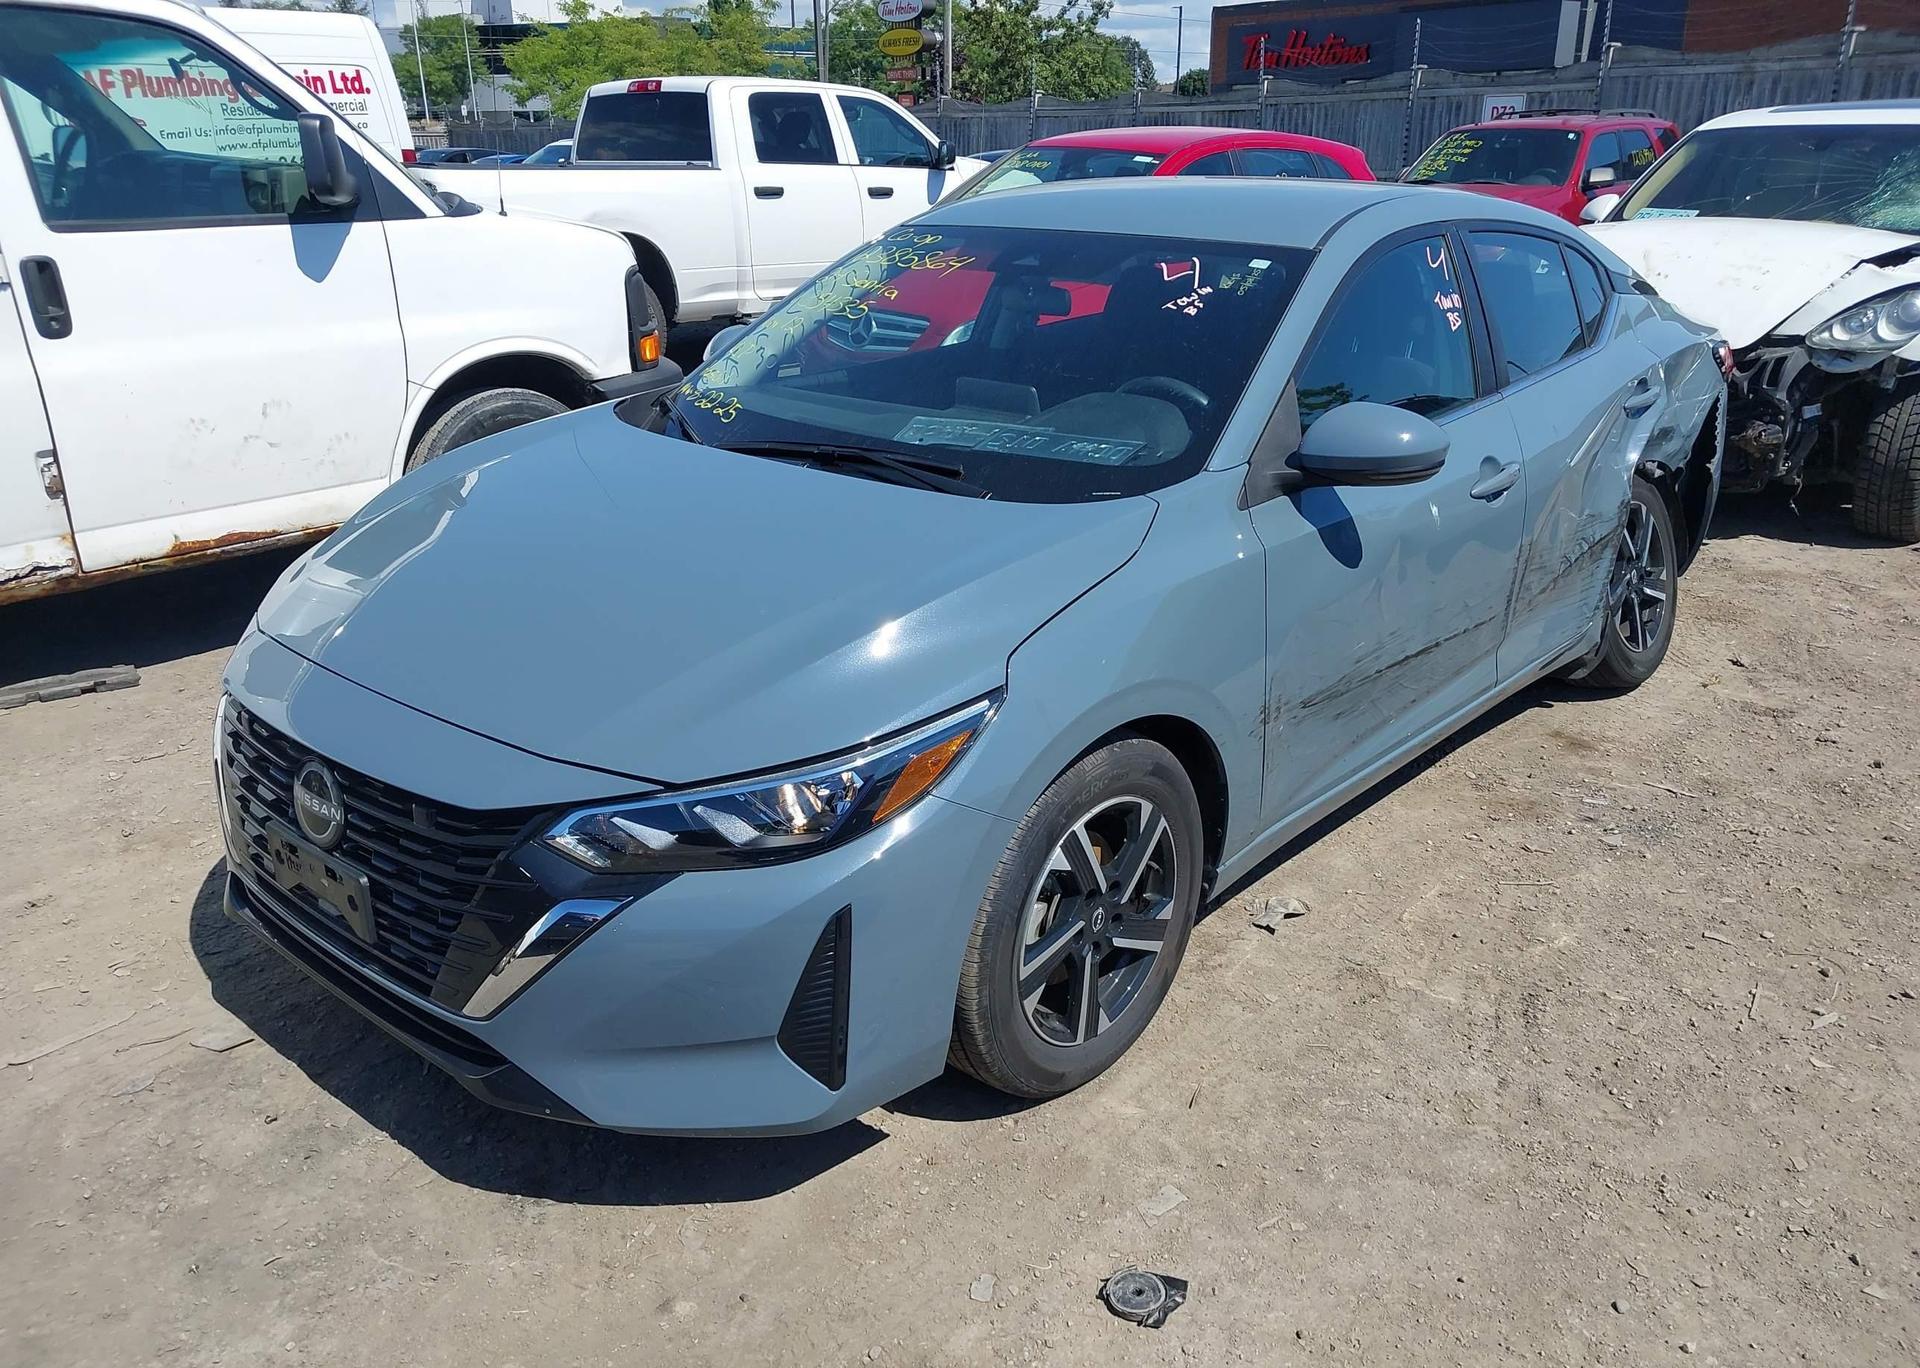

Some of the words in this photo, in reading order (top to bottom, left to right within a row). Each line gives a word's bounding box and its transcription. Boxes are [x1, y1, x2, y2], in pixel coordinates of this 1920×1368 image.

[881, 2, 895, 17] Tim
[902, 36, 920, 46] FRESH
[1280, 29, 1370, 69] Hortons
[120, 67, 240, 103] Plumbing
[328, 69, 371, 95] Ltd.
[159, 127, 192, 140] Email
[194, 127, 212, 138] Us:
[298, 789, 341, 821] ISSAN
